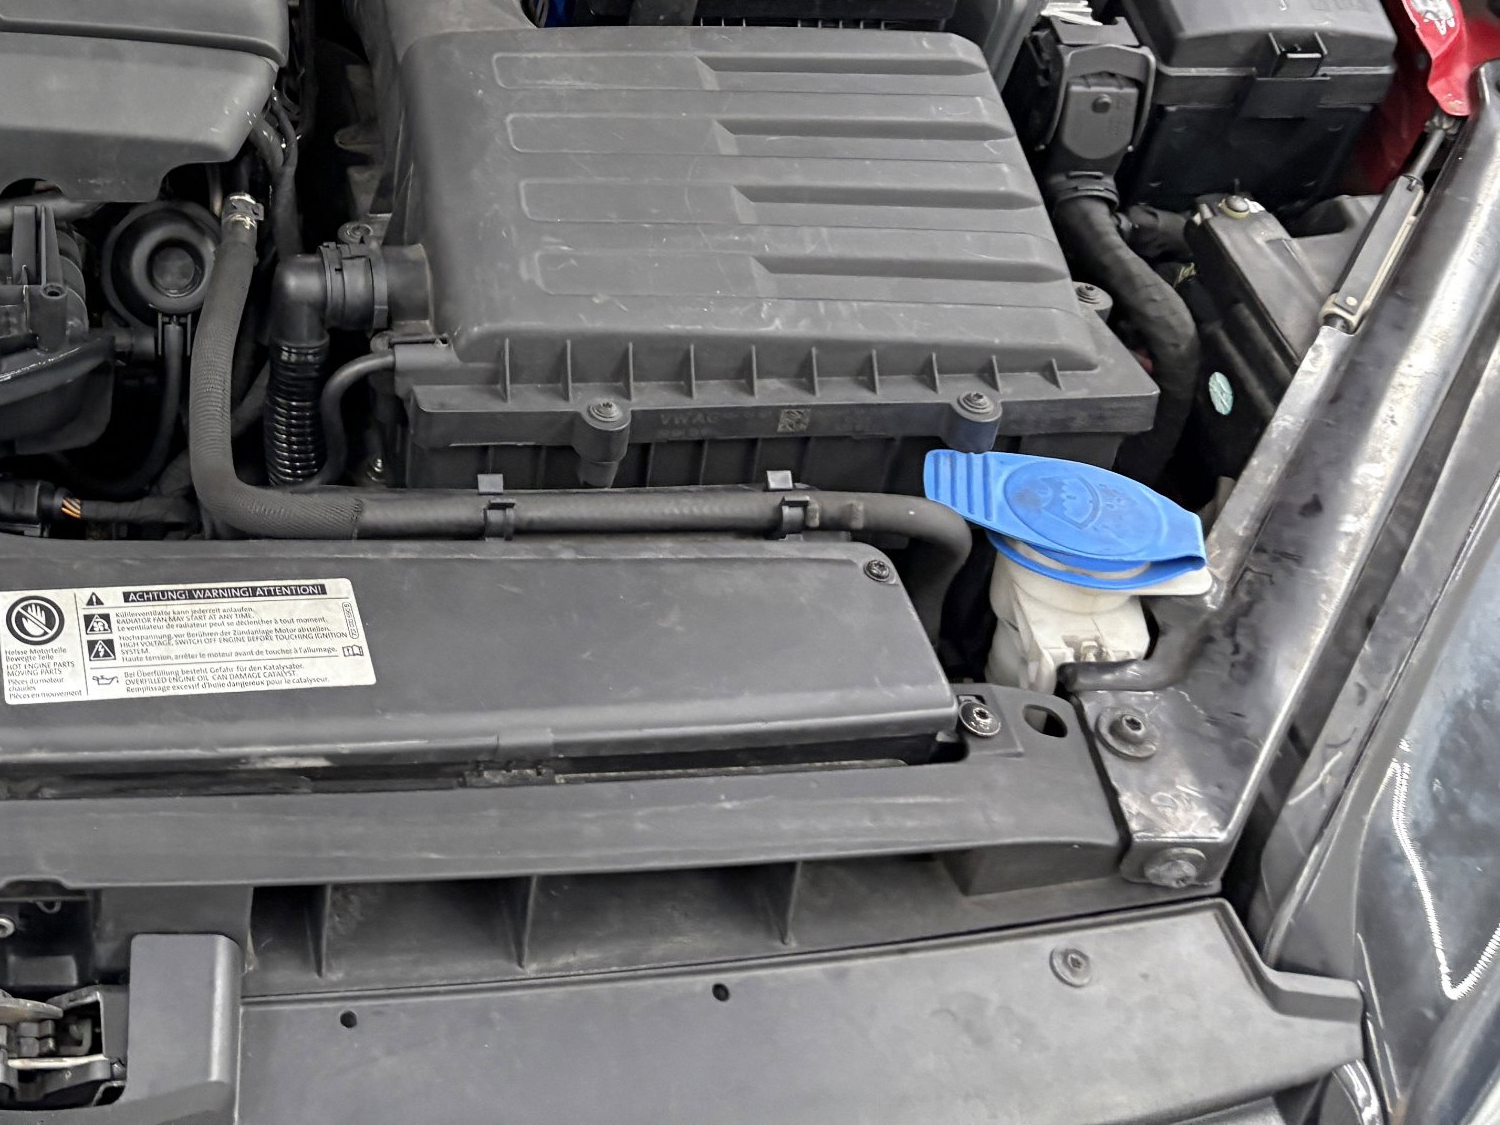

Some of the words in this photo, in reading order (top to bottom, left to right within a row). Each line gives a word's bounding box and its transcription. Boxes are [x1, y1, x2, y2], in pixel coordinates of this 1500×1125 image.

[128, 590, 190, 601] ACHTUNG!
[192, 587, 252, 599] WARNING!
[256, 585, 321, 597] ATTENTION!
[116, 617, 152, 625] RADIATOR
[168, 615, 184, 623] MAY
[127, 623, 164, 631] ventilateur
[176, 621, 208, 629] radiateur
[210, 619, 226, 629] peut
[175, 638, 202, 646] SWITCH
[204, 637, 218, 645] OFF
[275, 633, 314, 641] TOUCHING
[314, 631, 348, 639] IGNITION
[208, 651, 232, 659] moteur
[6, 663, 22, 671] HOT
[24, 662, 51, 670] ENGINE
[7, 669, 39, 677] MOVING
[230, 673, 261, 681] DAMAGE
[266, 679, 282, 687] pour
